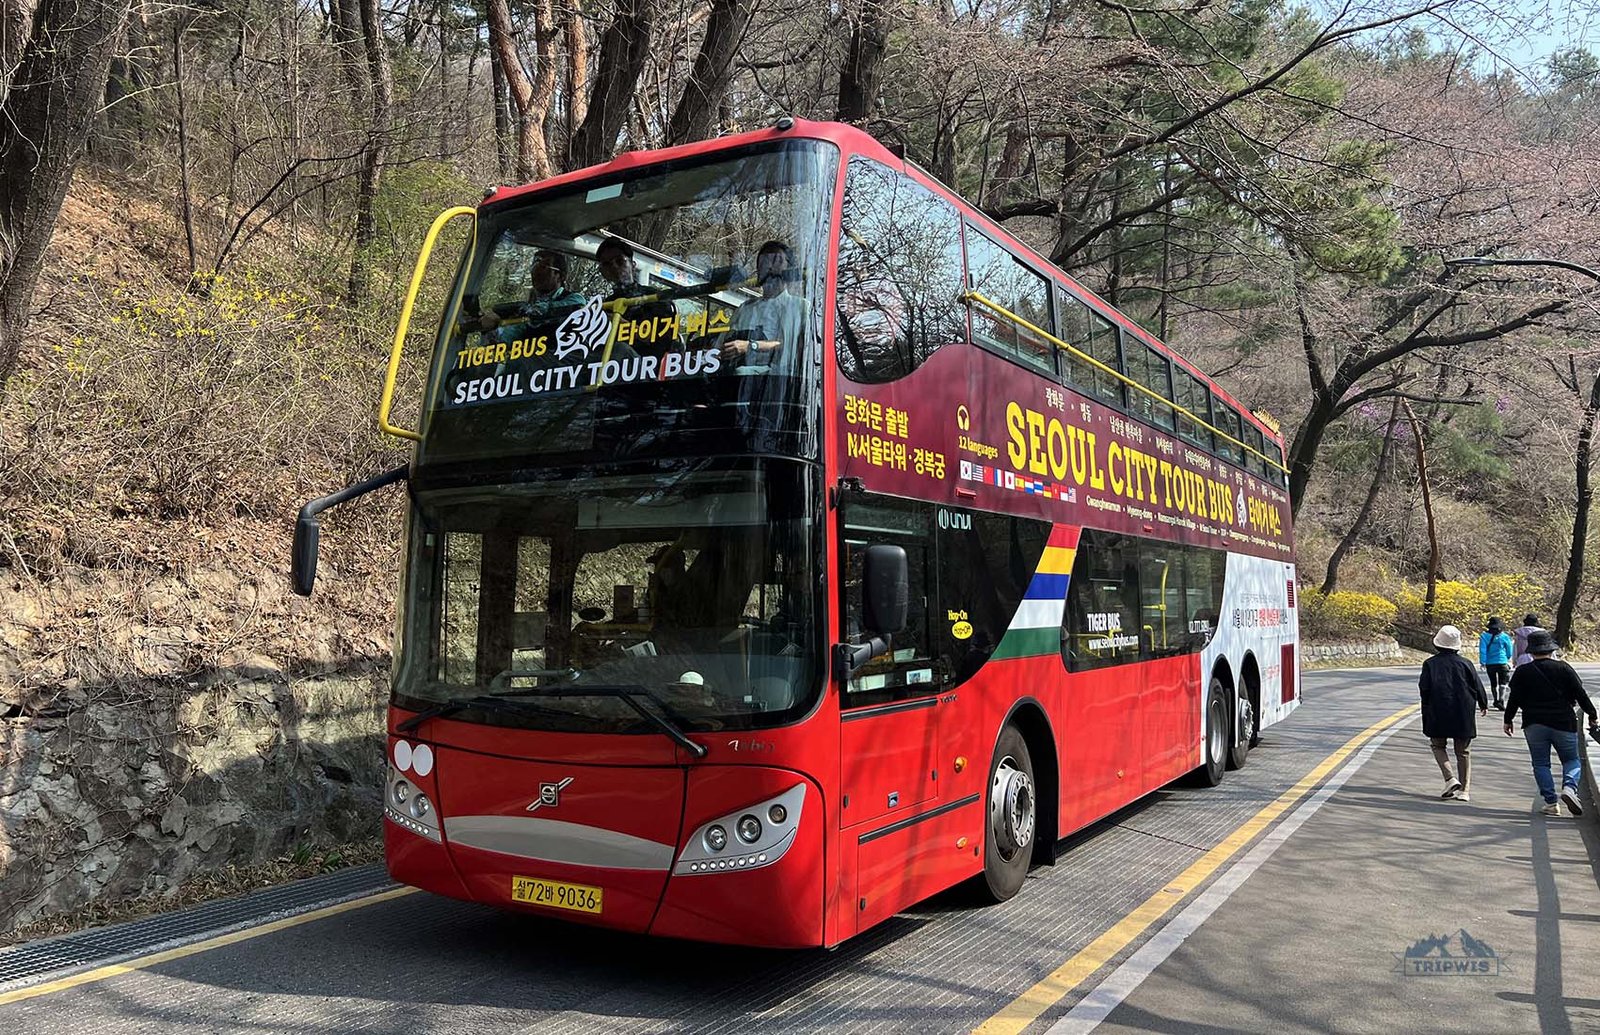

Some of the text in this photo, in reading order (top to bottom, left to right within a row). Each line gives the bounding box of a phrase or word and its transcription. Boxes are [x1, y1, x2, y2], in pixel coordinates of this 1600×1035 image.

[617, 310, 730, 346] 타이거 버스
[458, 335, 548, 369] TIGER BUS
[454, 349, 721, 404] SEOUL CITY TOUR BUS
[844, 394, 909, 438] 광화문 출발
[958, 435, 998, 459] 12 languages
[1006, 401, 1233, 526] SEOUL CITY TOUR BUS
[1248, 495, 1282, 537] 타이거 버스
[948, 610, 968, 622] Hop-On
[1087, 612, 1121, 632] TIGER BUS
[557, 886, 596, 909] 9036
